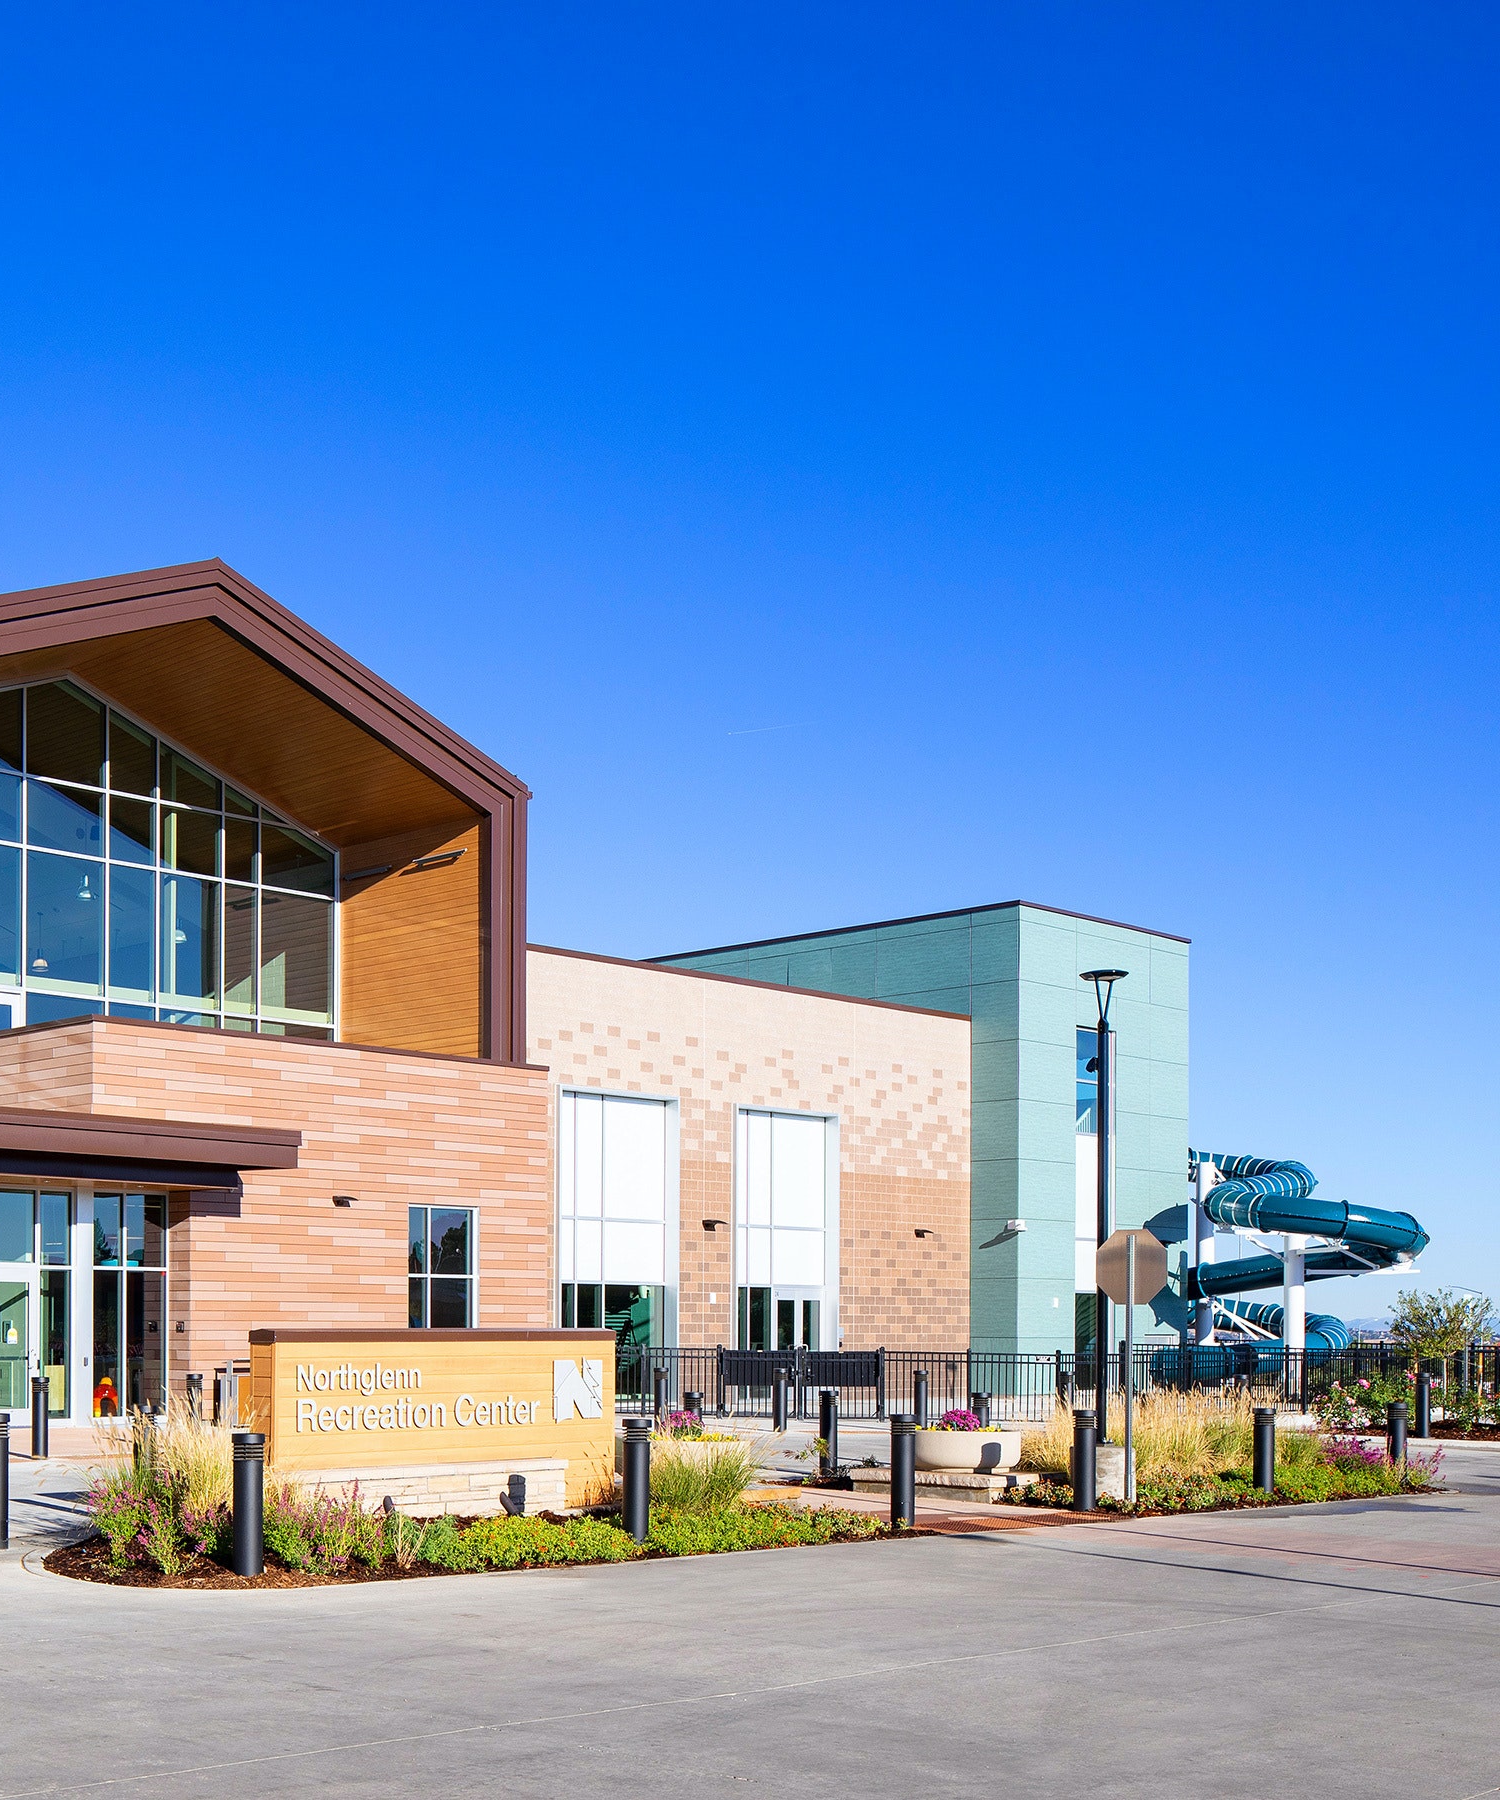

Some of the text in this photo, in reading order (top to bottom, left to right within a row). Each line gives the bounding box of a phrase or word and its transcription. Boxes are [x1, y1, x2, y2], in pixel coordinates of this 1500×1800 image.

[296, 1363, 421, 1396] Northglenn
[296, 1395, 541, 1433] Recreation Center
